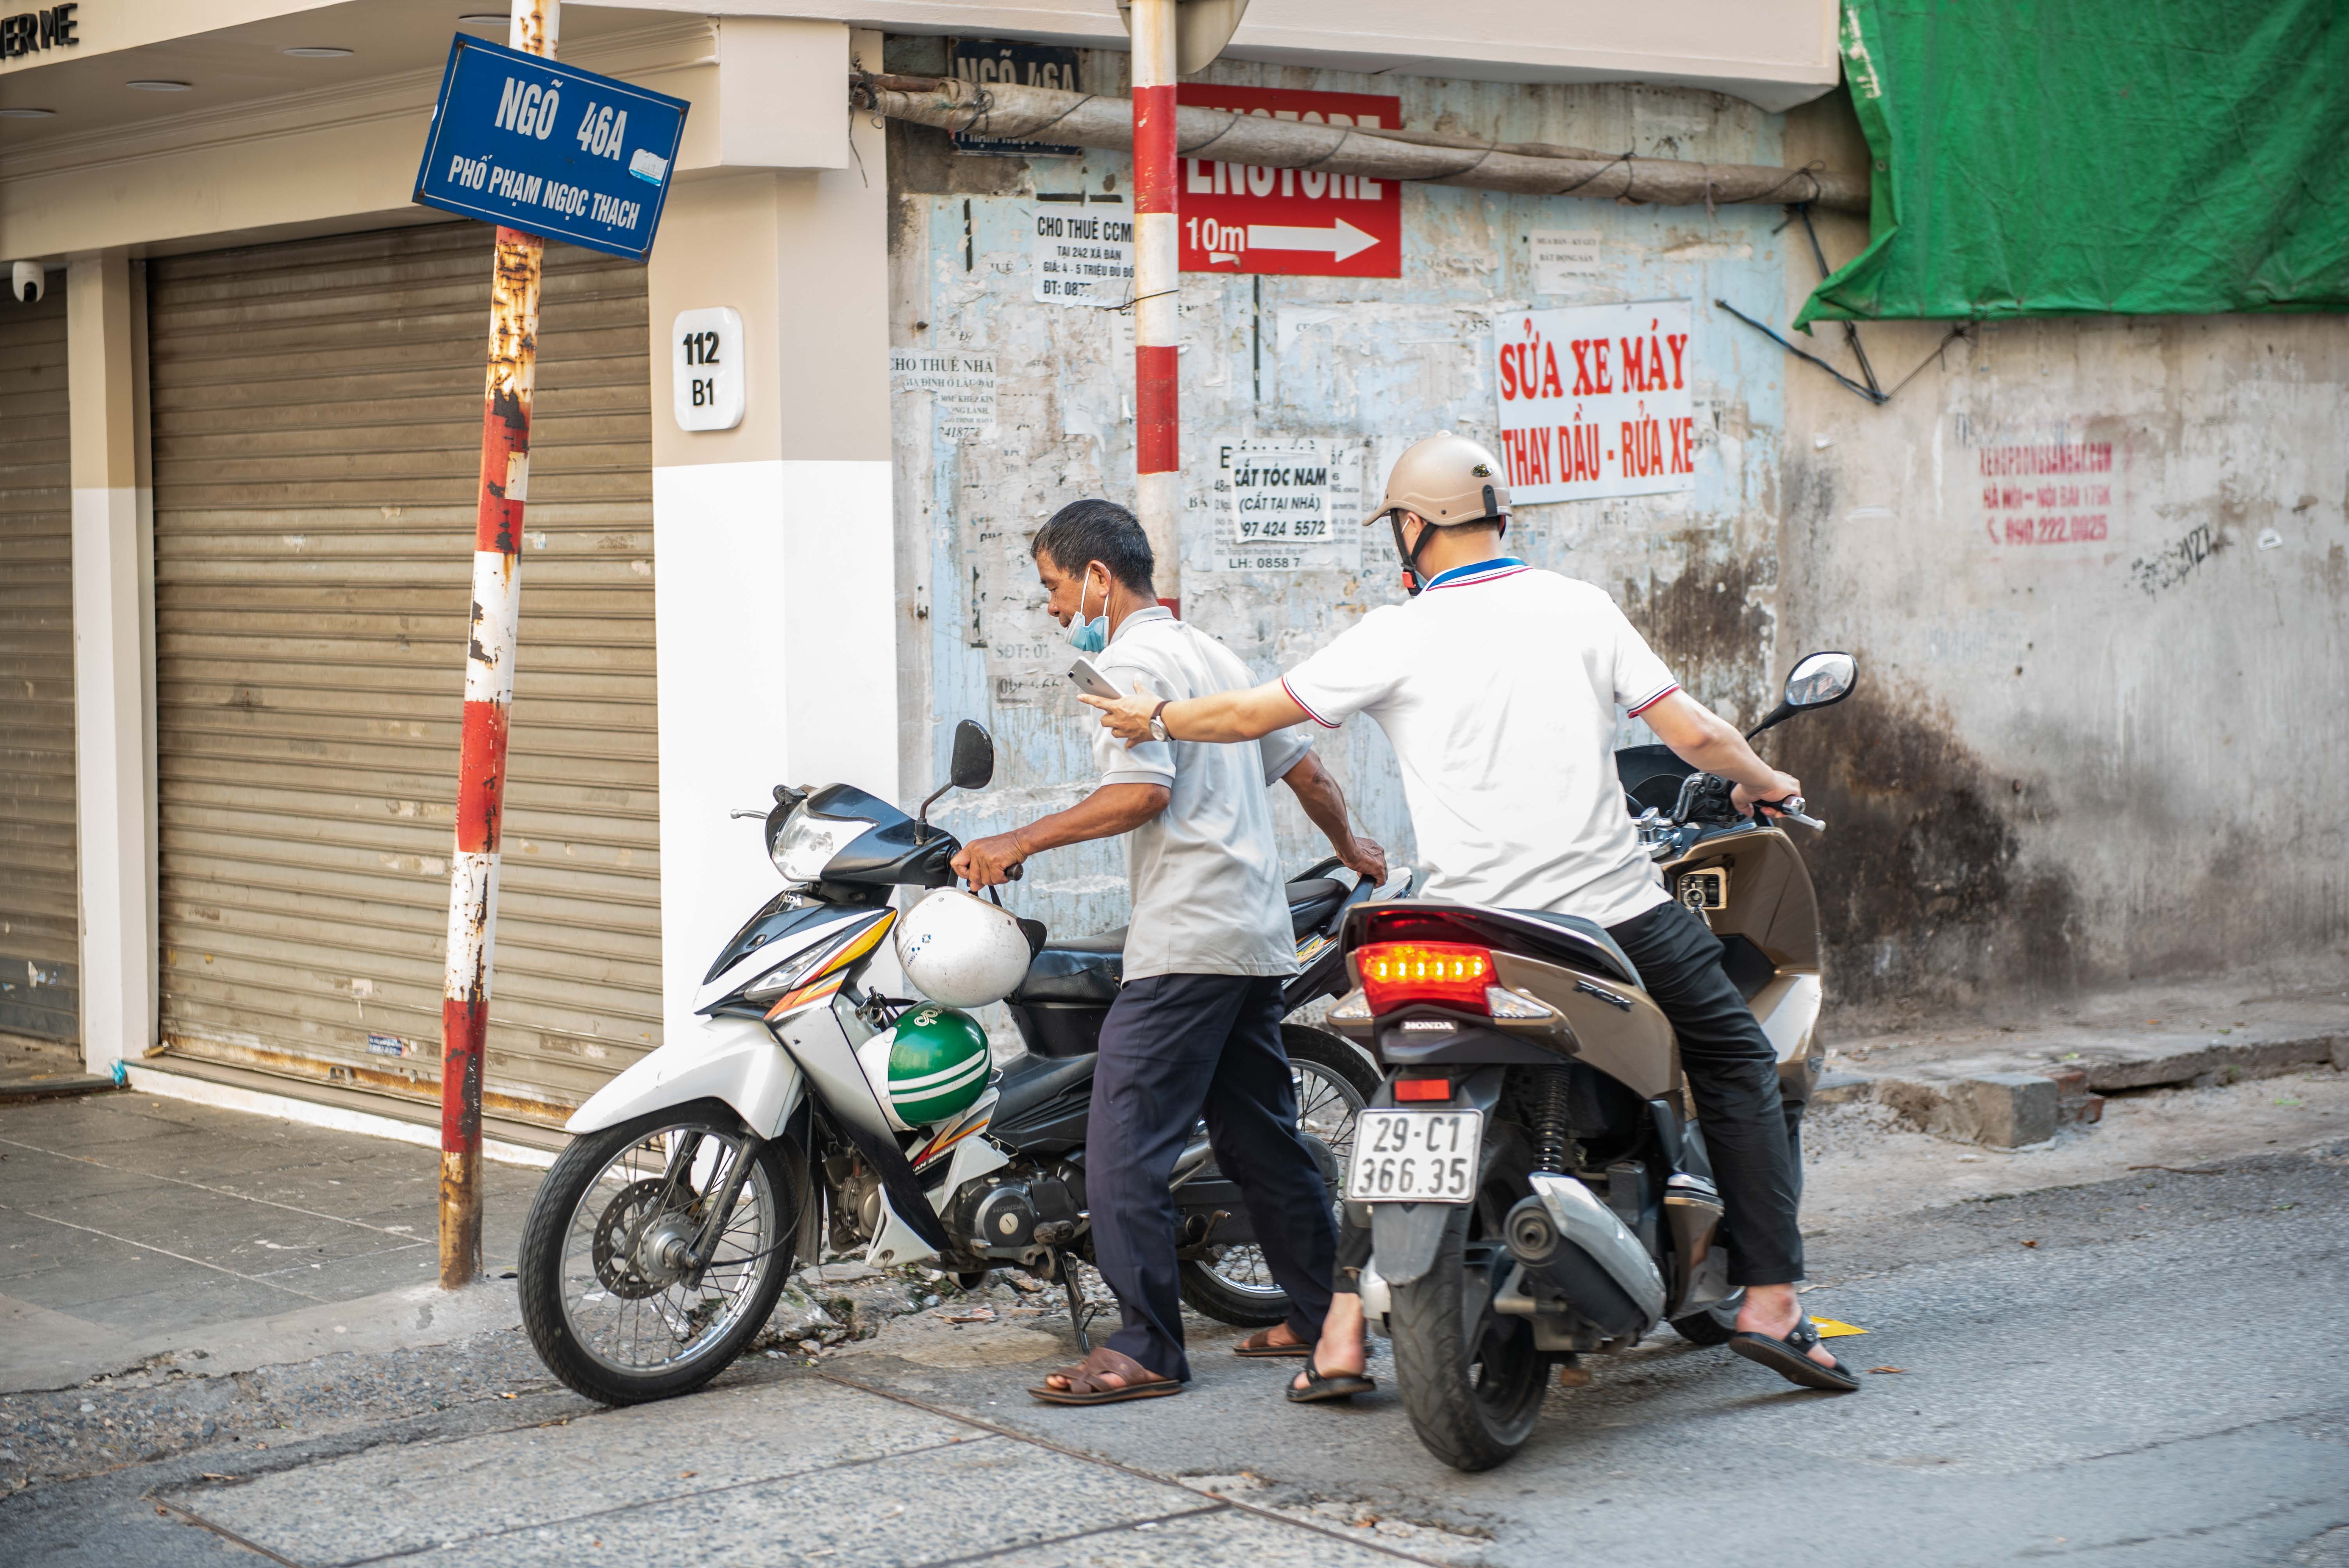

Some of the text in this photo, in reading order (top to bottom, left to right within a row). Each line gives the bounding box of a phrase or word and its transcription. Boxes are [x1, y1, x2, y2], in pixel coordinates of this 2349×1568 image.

[495, 77, 628, 161] NGÕ 46A
[447, 154, 641, 232] PHỐ PHẠM NGỌC THẠCH
[1037, 216, 1063, 238] CHO
[1067, 216, 1099, 240] THUÊ
[1185, 217, 1245, 252] 10m
[1072, 246, 1087, 258] 242
[1062, 263, 1068, 273] 4
[1075, 264, 1081, 275] 5
[1043, 280, 1061, 295] ĐT:
[683, 331, 720, 366] 112
[1499, 317, 1689, 402] SỬA XE MÁY
[920, 355, 959, 372] THUÊ
[963, 356, 994, 372] NHÀ
[692, 378, 714, 406] B1
[1501, 426, 1551, 487] THAY
[1558, 403, 1600, 484] DẦU
[1621, 399, 1663, 479] RỬA
[1669, 417, 1694, 474] XE
[1235, 459, 1327, 487] CẮT TÓC NAM
[1239, 491, 1321, 514] (CẮT TẠI NHÀ)
[1240, 522, 1260, 537] 97
[1262, 521, 1287, 536] 424
[1294, 520, 1326, 536] 5572
[1229, 557, 1301, 569] LH: 0858 7
[1573, 979, 1636, 1012] PCX
[1404, 1021, 1454, 1030] HONDA
[1372, 1116, 1461, 1153] 29-C1
[913, 1161, 927, 1172] AN
[1358, 1157, 1468, 1195] 366.35
